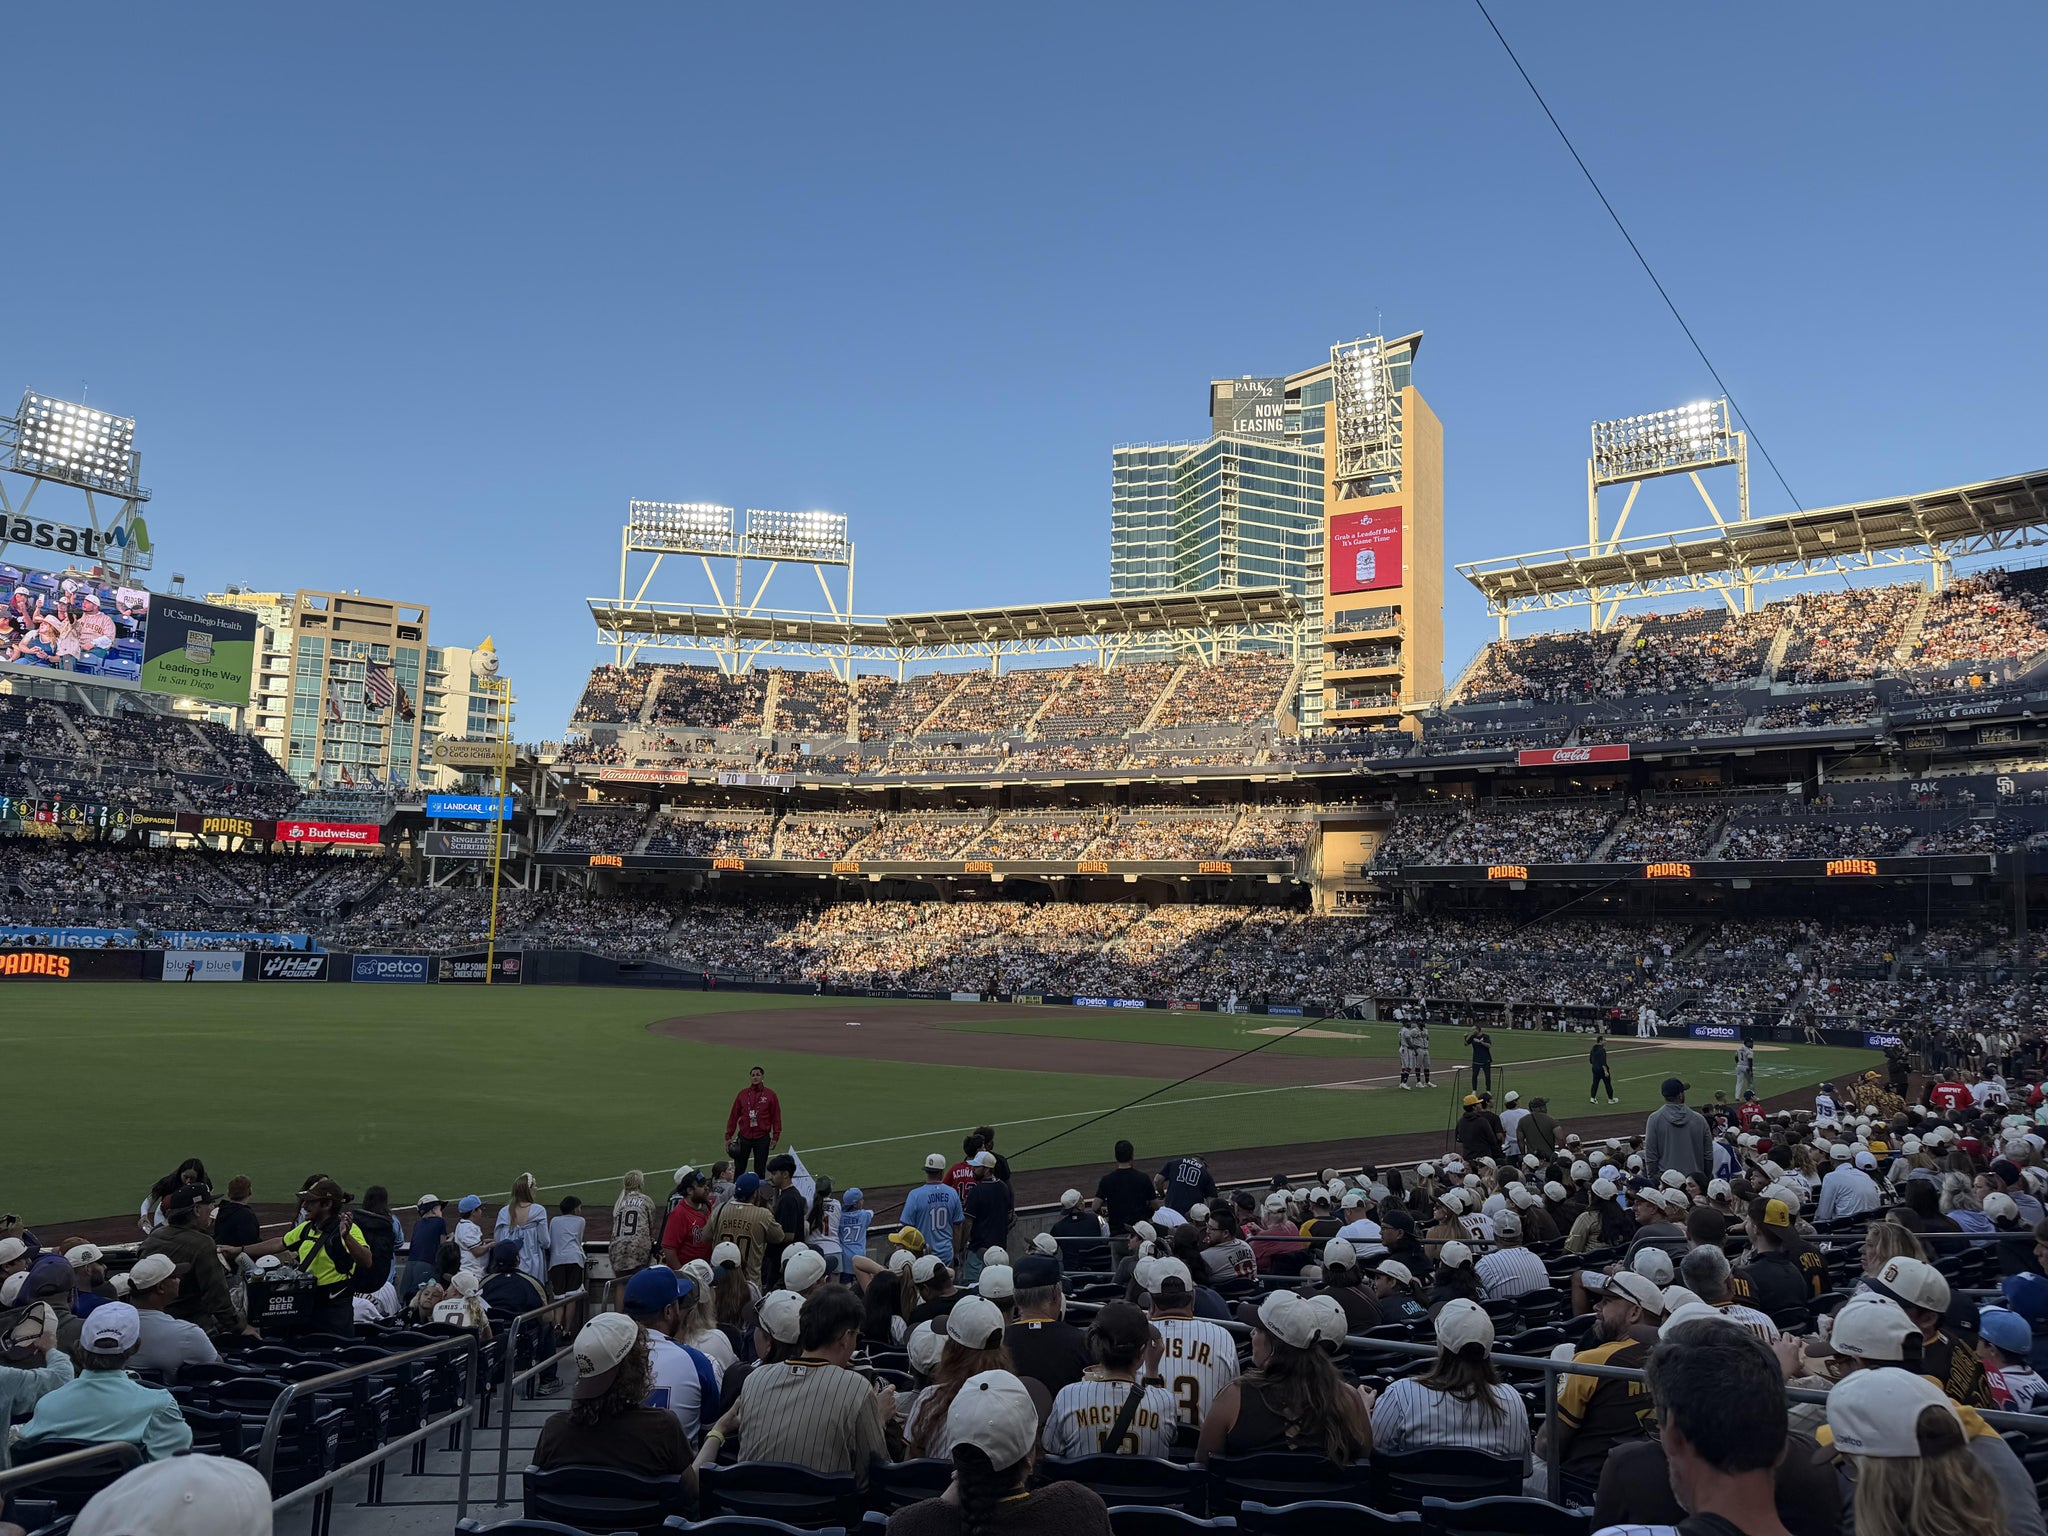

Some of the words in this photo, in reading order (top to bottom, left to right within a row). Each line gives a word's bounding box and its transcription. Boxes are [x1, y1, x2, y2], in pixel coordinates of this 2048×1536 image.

[1234, 382, 1264, 392] PARK
[1262, 388, 1272, 396] 12
[1256, 404, 1283, 417] NOW
[1234, 418, 1283, 432] LEASING
[1357, 529, 1381, 538] Leadoff
[163, 608, 176, 618] UC
[177, 611, 193, 622] San
[194, 614, 216, 626] Diego
[217, 618, 242, 631] Health
[189, 632, 210, 642] BEST
[160, 661, 200, 676] Leading
[202, 668, 218, 678] the
[221, 670, 242, 684] Way
[158, 674, 166, 682] in
[170, 676, 186, 685] San
[190, 679, 214, 690] Diego
[1916, 711, 1944, 720] STEVE
[1950, 709, 1956, 717] 6
[1962, 706, 1999, 716] GARVEY
[1552, 748, 1591, 762] Coca-Cola
[602, 769, 650, 781] Tarantino
[650, 773, 686, 782] SAUSAGES
[760, 775, 780, 785] 7:07
[1910, 782, 1939, 793] RAK
[3, 798, 8, 808] 2
[53, 802, 59, 812] 2
[3, 809, 7, 818] 1
[20, 806, 27, 814] 9
[70, 809, 76, 819] 8
[101, 806, 107, 816] 2
[52, 812, 58, 822] 3
[100, 817, 106, 827] 0
[117, 813, 123, 823] 6
[143, 816, 175, 825] @PADRES
[203, 818, 252, 837] PADRES
[308, 828, 367, 839] Budweiser
[452, 836, 495, 844] SINGLETON
[590, 855, 622, 867] PADRES
[713, 858, 744, 870] PADRES
[832, 862, 859, 873] PADRES
[964, 862, 993, 872] PADRES
[1077, 862, 1108, 873] PADRES
[1199, 862, 1231, 873] PADRES
[1646, 863, 1691, 878] PADRES
[1826, 860, 1877, 876] PADRES
[1488, 866, 1527, 880] PADRES
[166, 960, 190, 969] blue
[206, 960, 231, 969] blue
[283, 958, 324, 970] H2O
[377, 960, 423, 975] petco
[1707, 1028, 1734, 1036] petco
[1881, 1036, 1900, 1045] petc
[1945, 1095, 1956, 1108] 3
[1817, 1103, 1832, 1117] 35
[952, 1168, 974, 1179] ACUÑA
[1176, 1164, 1201, 1186] 10
[927, 1193, 950, 1204] JONES
[616, 1211, 638, 1236] 19
[929, 1207, 947, 1231] 10
[723, 1220, 751, 1231] SHEETS
[843, 1226, 861, 1242] 27
[269, 1296, 294, 1304] COLD
[1187, 1341, 1214, 1368] JR.
[1076, 1405, 1159, 1430] MACHDO
[1566, 1498, 1579, 1509] pet
